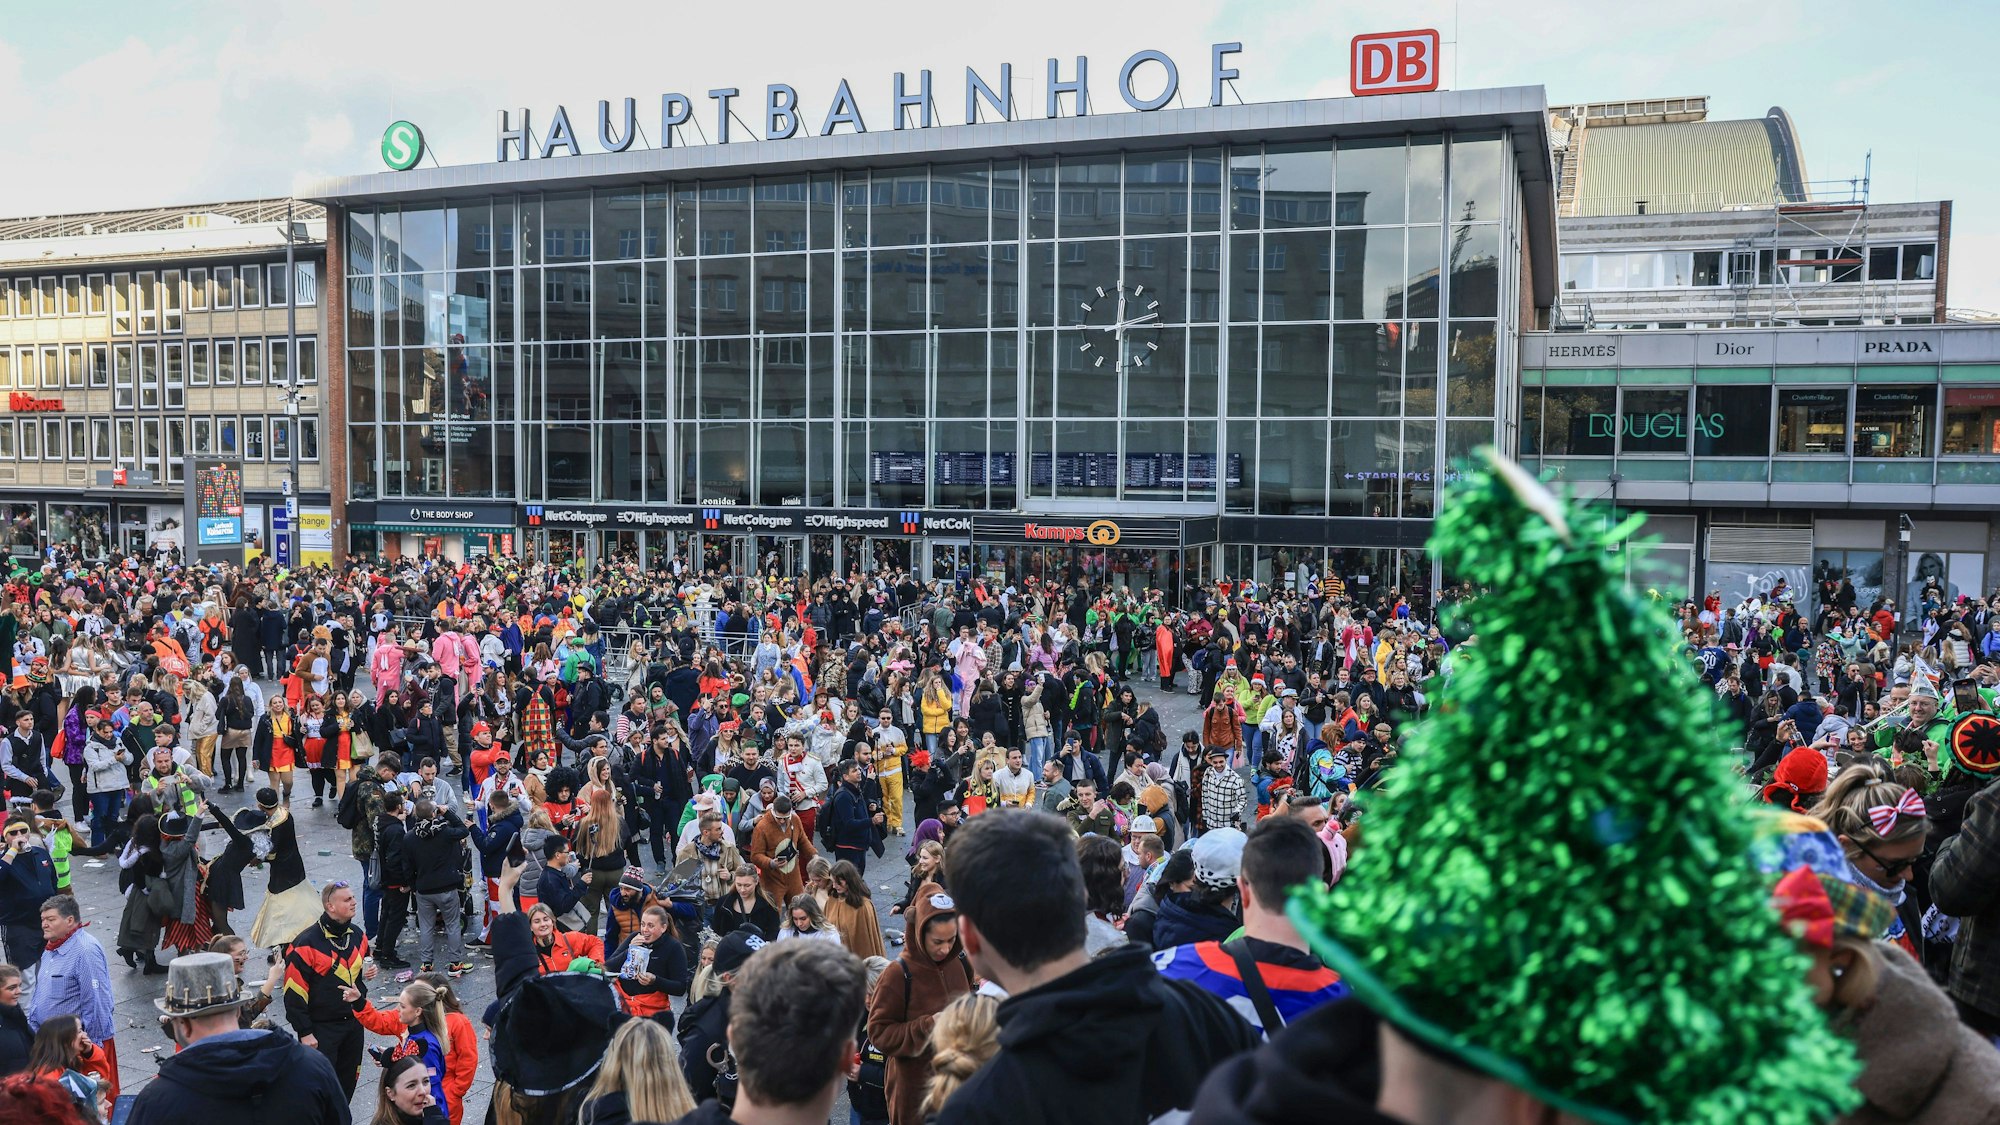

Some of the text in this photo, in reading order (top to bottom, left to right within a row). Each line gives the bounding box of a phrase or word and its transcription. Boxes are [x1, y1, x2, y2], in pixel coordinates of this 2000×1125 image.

[1361, 39, 1429, 85] DB
[496, 41, 1243, 163] HAUPTBAHNHOF
[387, 126, 414, 164] S
[1716, 342, 1755, 355] Dior
[1865, 342, 1932, 353] PRADA
[1589, 413, 1725, 438] DOUGLAS
[1357, 471, 1430, 481] STARBUCKS
[702, 496, 736, 505] eonidas
[436, 511, 454, 519] BODY
[455, 511, 473, 519] SHOP
[545, 510, 694, 526] NetCologne Highspeed
[723, 513, 889, 530] NetCologne Highspeed
[1024, 522, 1085, 543] Kamps
[1703, 654, 1717, 667] 20
